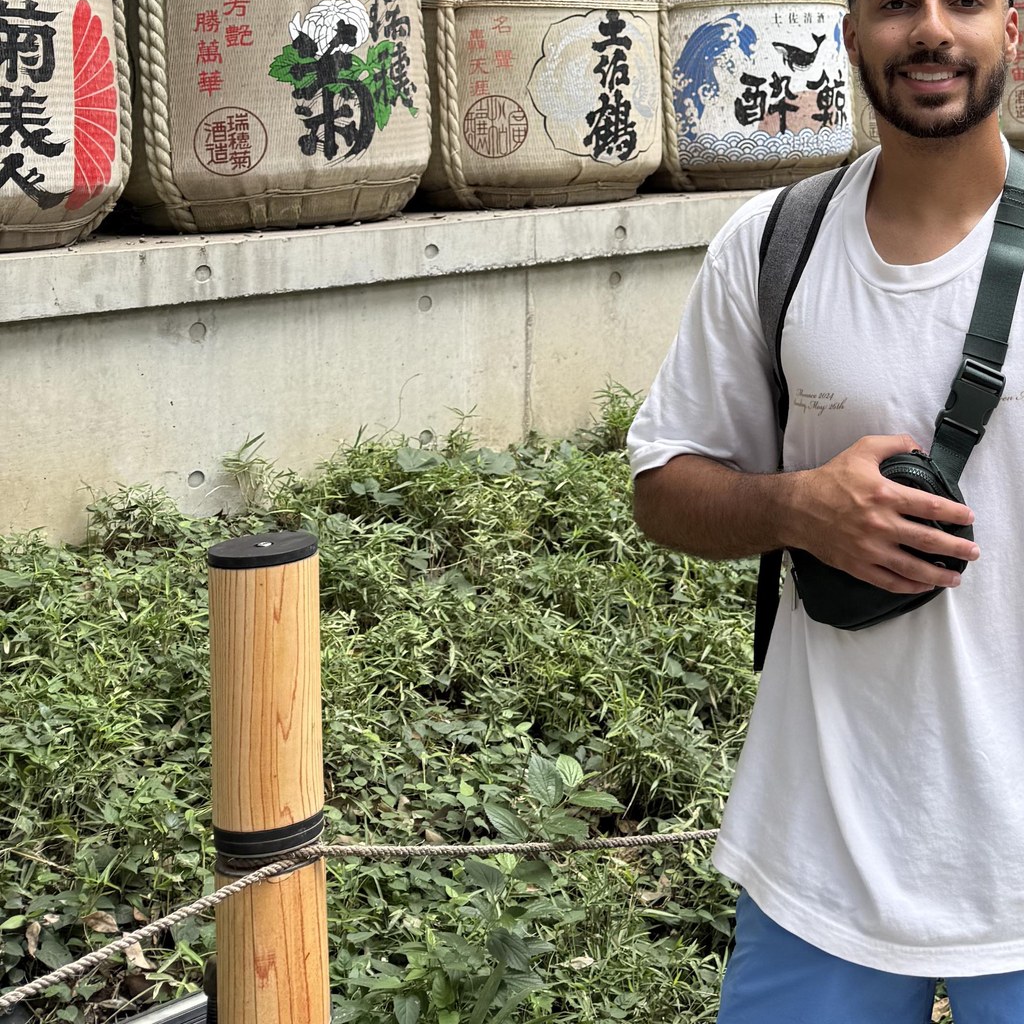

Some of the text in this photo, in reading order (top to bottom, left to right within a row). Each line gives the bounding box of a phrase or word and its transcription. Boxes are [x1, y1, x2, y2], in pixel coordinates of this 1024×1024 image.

[582, 9, 637, 162] 土佐鶴
[733, 69, 848, 136] 酔鯨
[203, 121, 228, 167] 酒造
